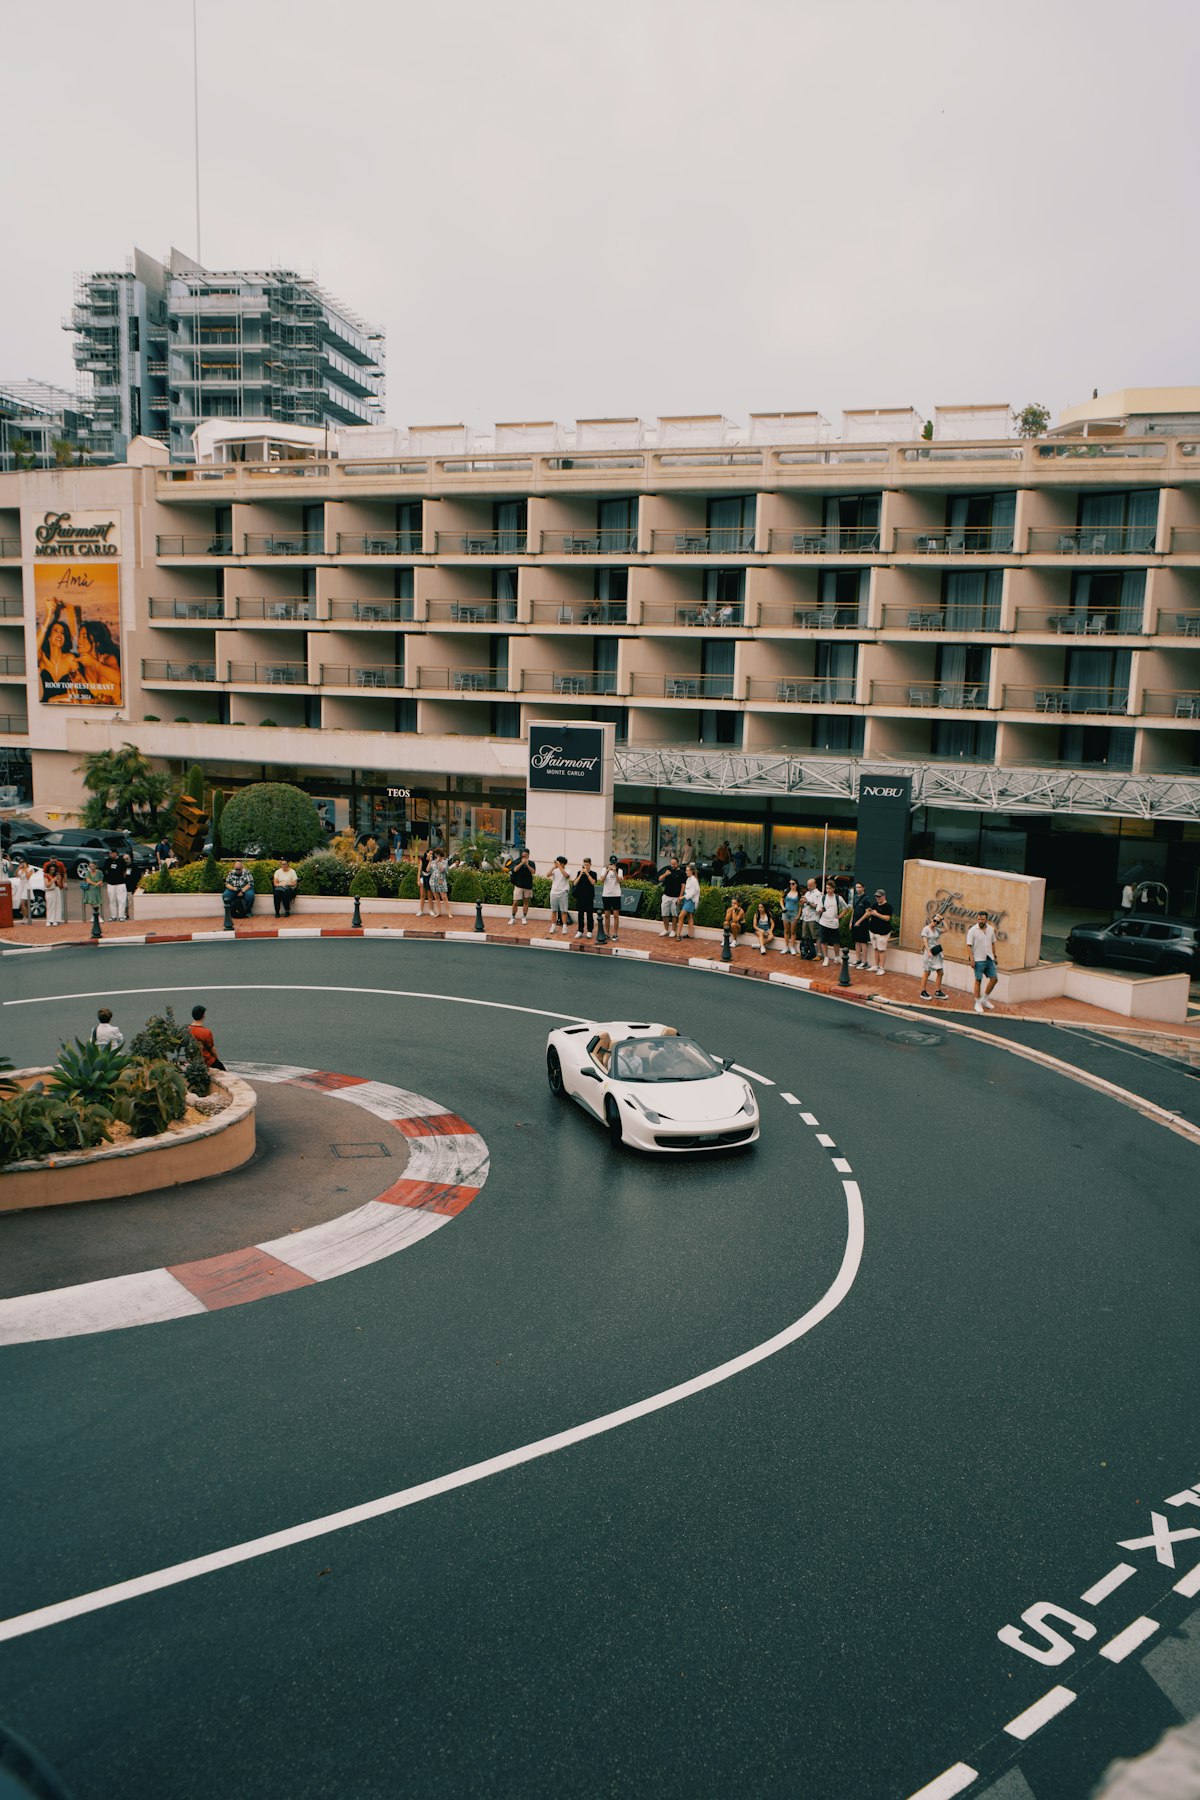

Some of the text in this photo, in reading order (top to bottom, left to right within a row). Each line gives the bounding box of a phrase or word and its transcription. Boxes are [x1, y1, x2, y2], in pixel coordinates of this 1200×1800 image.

[35, 512, 116, 543] Fairmont
[35, 544, 118, 556] MONTE CARLO
[44, 681, 115, 690] ROOFTOP RESTAURANT
[531, 745, 600, 771] Fairmont
[387, 788, 411, 798] TEOS
[862, 786, 905, 798] NOBU
[926, 888, 1009, 929] Fairmnt
